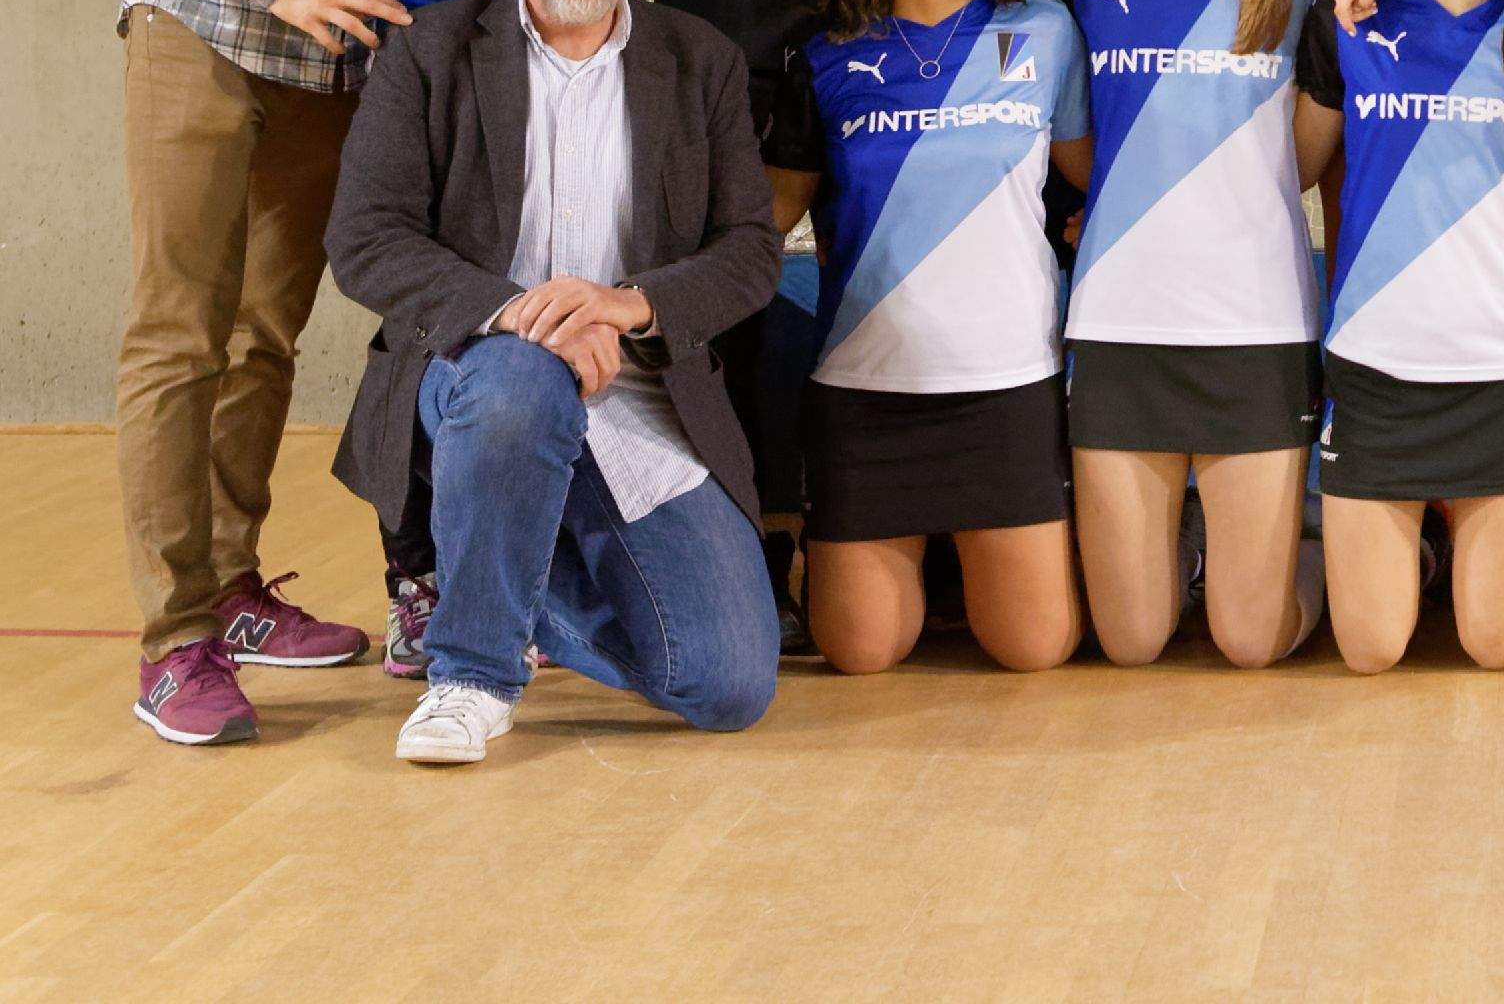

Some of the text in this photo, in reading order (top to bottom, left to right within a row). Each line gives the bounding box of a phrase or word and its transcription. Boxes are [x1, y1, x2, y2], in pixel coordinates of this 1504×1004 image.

[1111, 48, 1282, 79] INTERSPORT
[868, 100, 1041, 133] INTERSPORT
[224, 612, 276, 652] N
[149, 671, 178, 715] N
